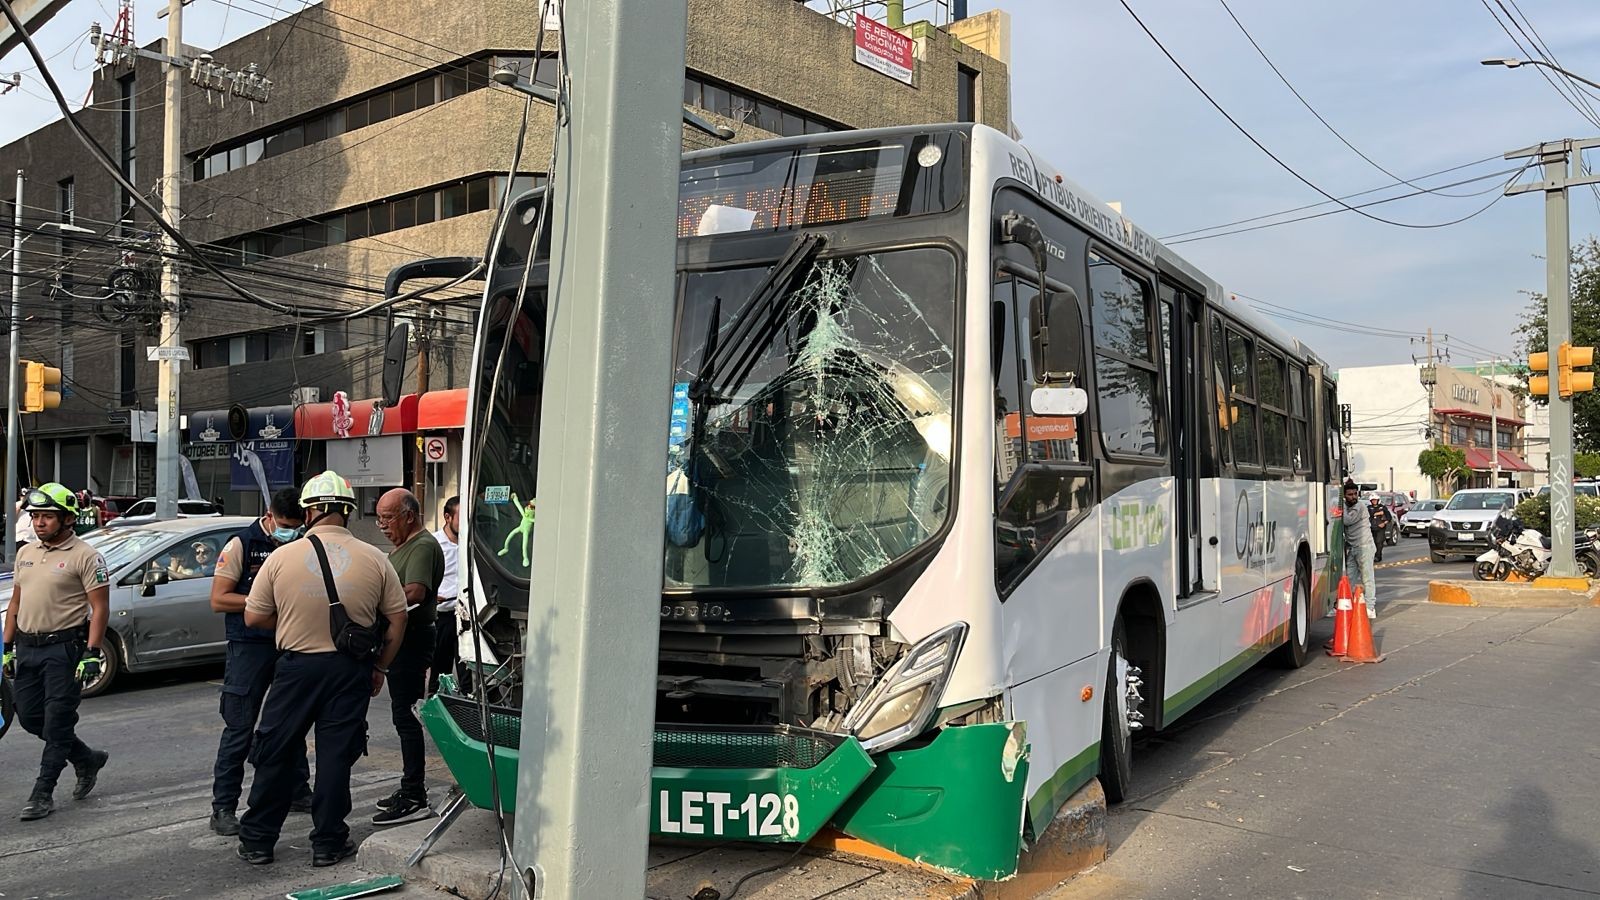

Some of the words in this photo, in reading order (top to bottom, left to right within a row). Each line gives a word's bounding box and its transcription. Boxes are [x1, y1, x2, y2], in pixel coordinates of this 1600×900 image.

[860, 20, 872, 32] SE
[874, 26, 908, 49] RENTAN
[864, 32, 904, 56] OFICINAS
[1009, 152, 1033, 186] RED
[1077, 197, 1114, 239] ORIENTE
[1134, 230, 1144, 253] DE
[1112, 503, 1165, 550] LET-128
[660, 789, 800, 838] LET-128
